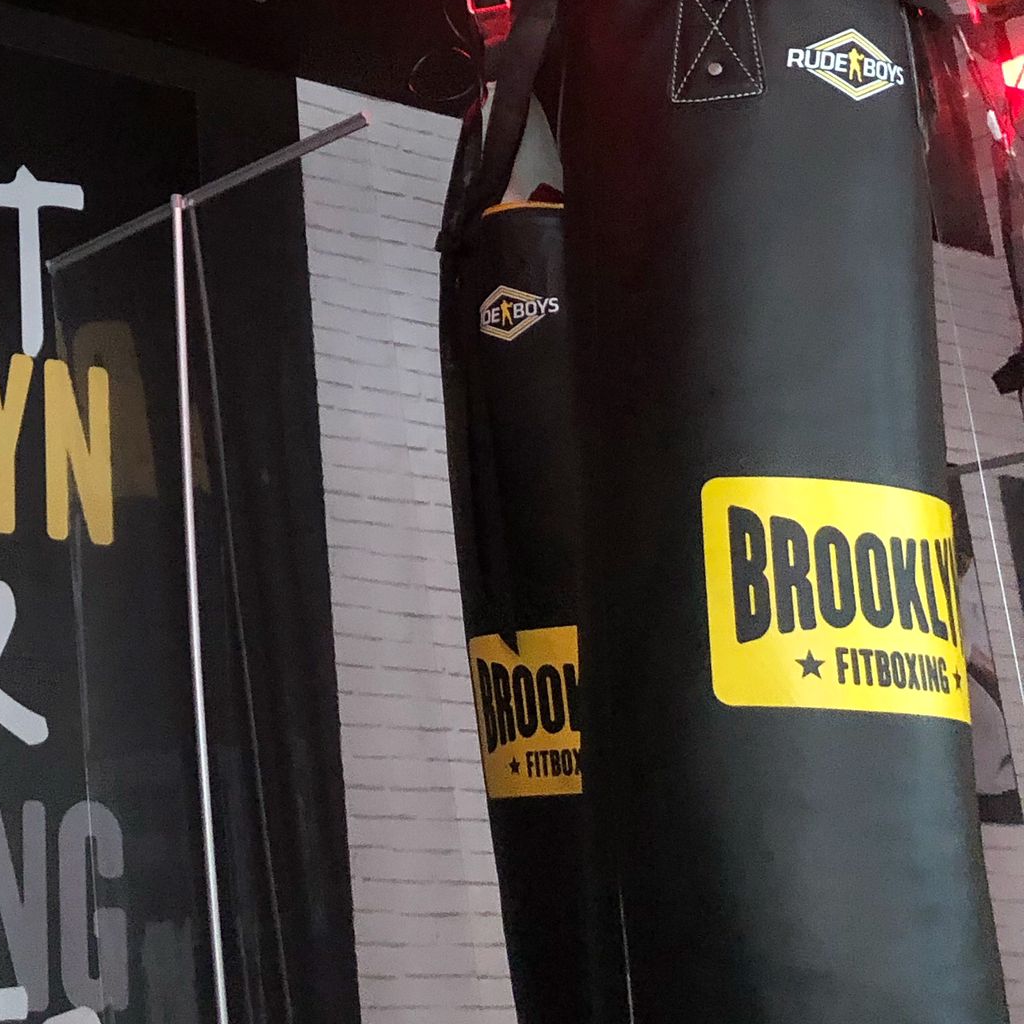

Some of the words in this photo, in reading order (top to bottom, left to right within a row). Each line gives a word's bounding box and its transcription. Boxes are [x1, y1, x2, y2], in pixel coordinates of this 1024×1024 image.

[787, 48, 848, 73] RUDE
[863, 58, 905, 86] BOYS
[513, 297, 560, 319] BOYS
[835, 646, 951, 694] FITBOXING
